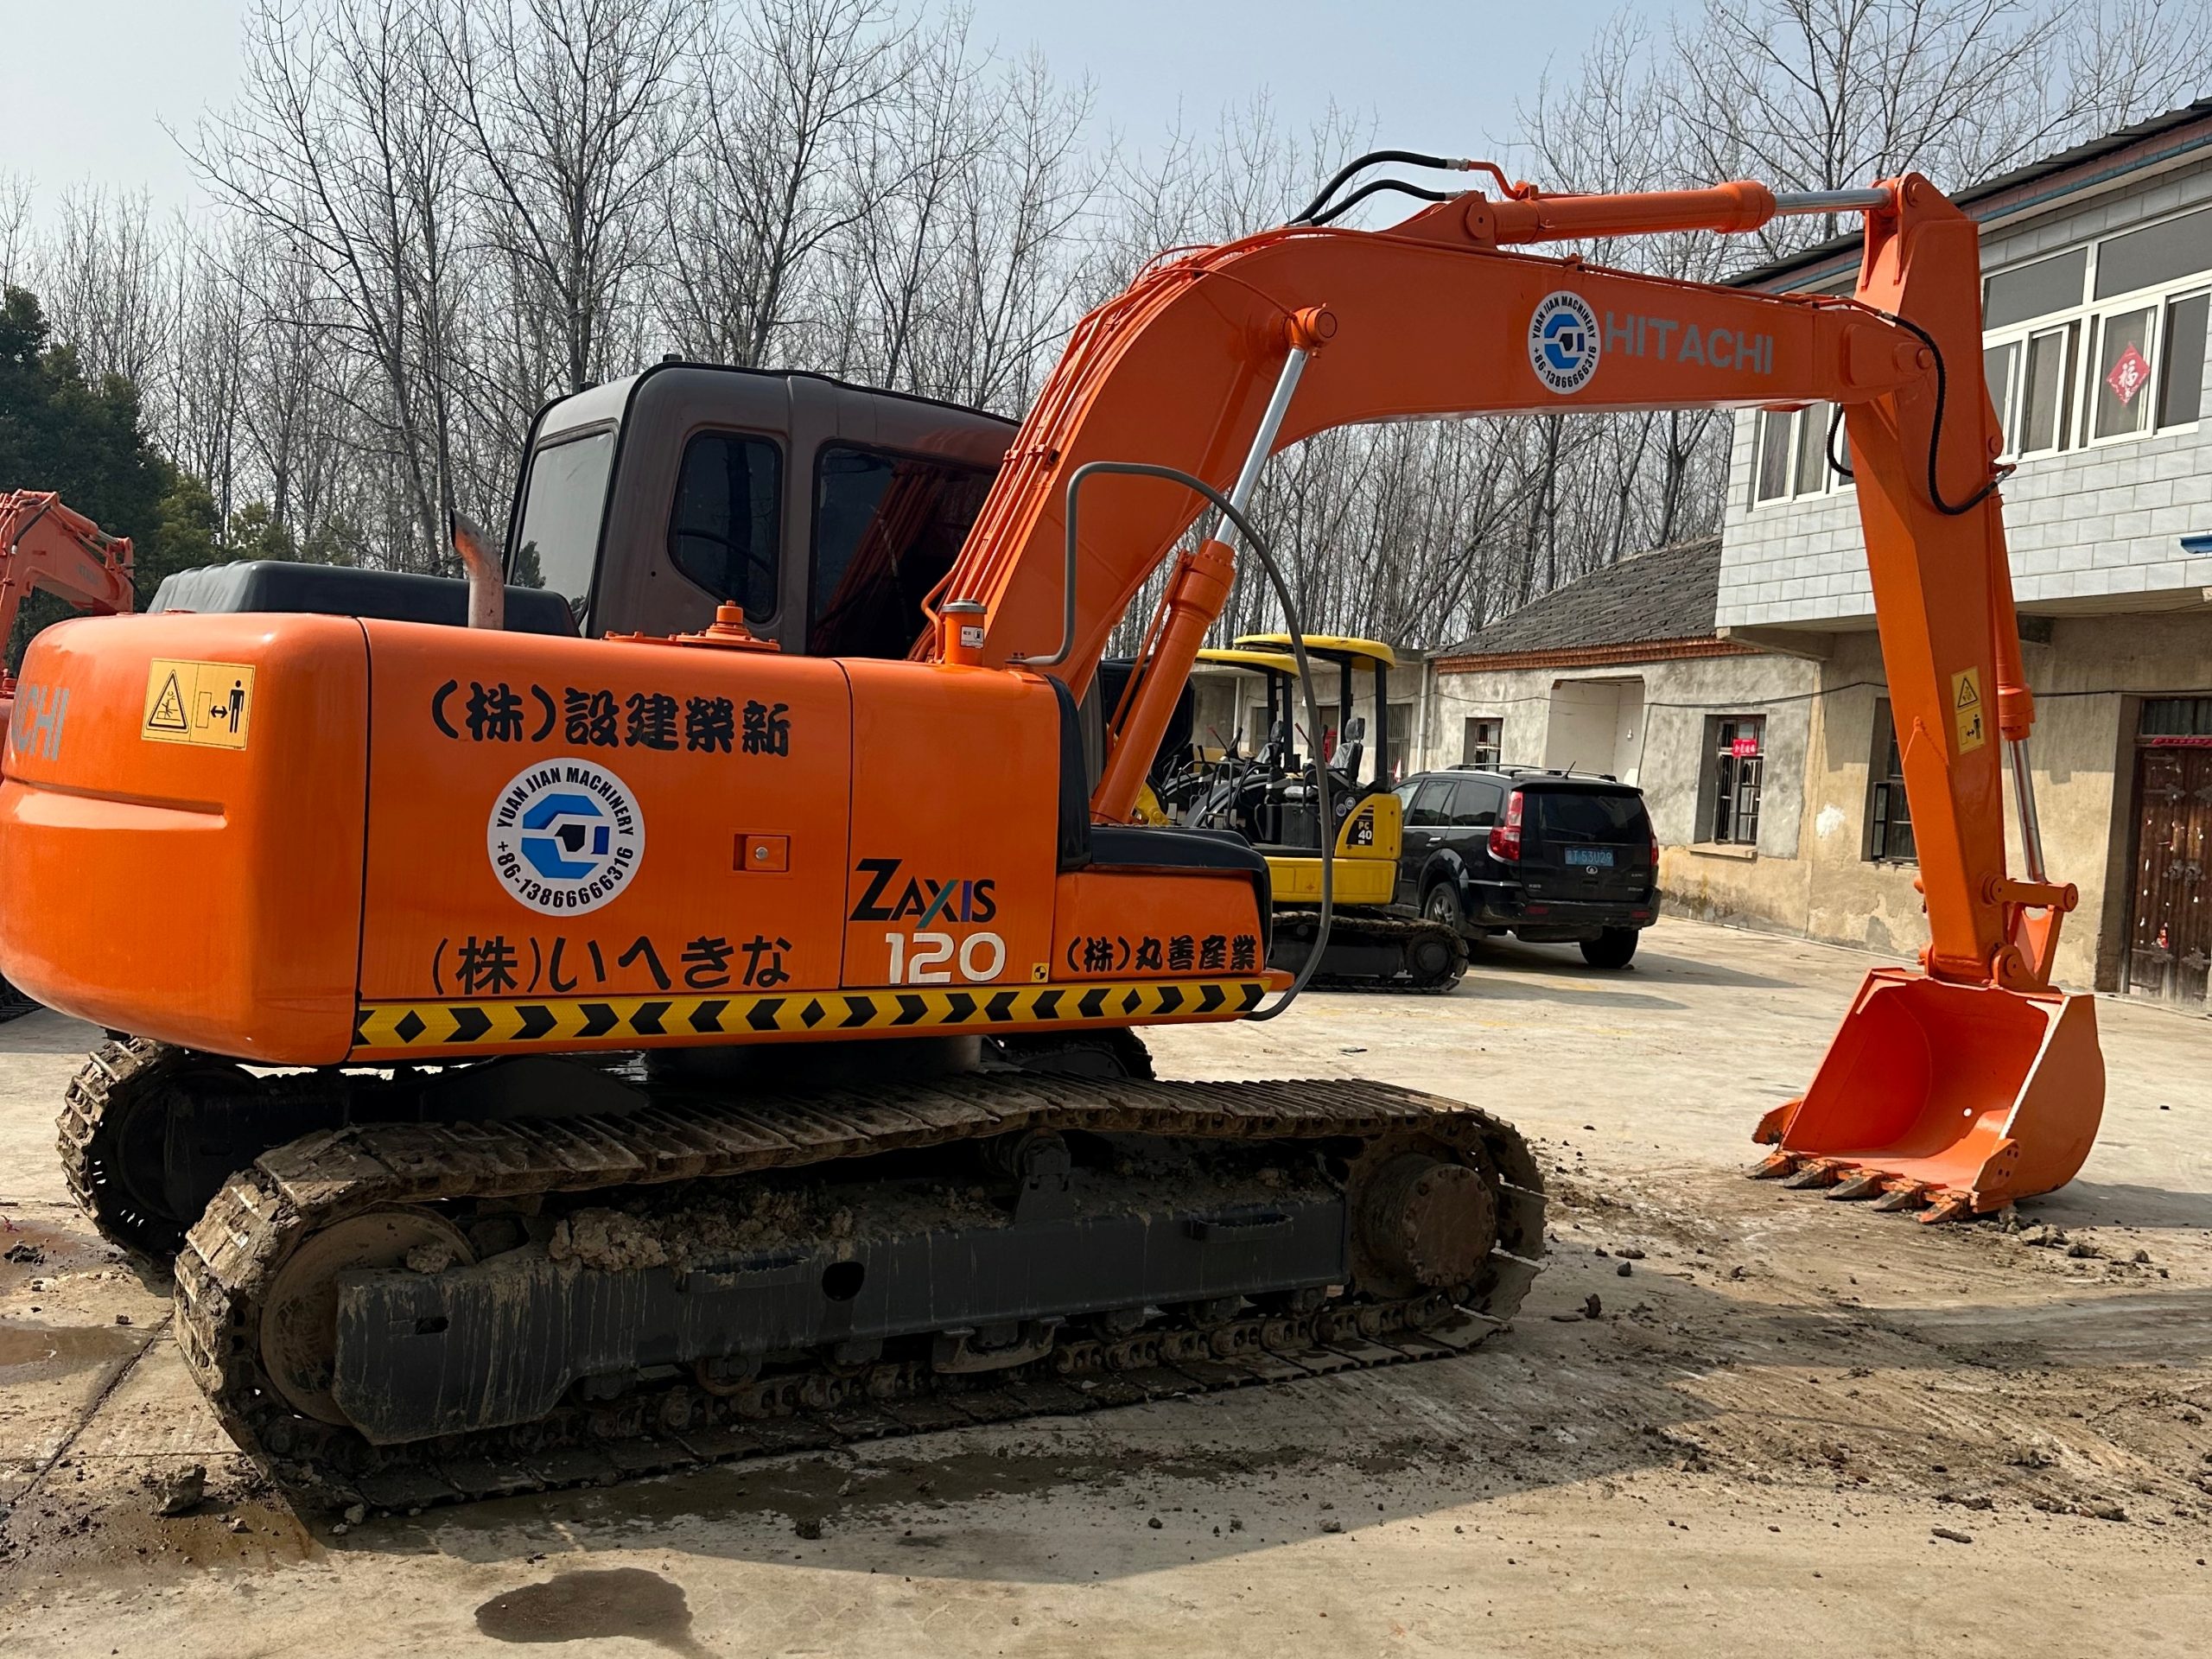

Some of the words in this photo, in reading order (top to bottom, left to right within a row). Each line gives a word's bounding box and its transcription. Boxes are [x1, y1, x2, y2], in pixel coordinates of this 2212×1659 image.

[1532, 312, 1546, 339] YUAN
[1543, 297, 1560, 315] JIAN
[1561, 296, 1597, 338] MACHINERY
[1605, 310, 1774, 375] HITACHI
[497, 785, 529, 828] YUAN
[525, 767, 562, 793] JIAN
[566, 766, 634, 836] MACHINERY
[1358, 821, 1370, 830] PC
[1357, 830, 1372, 840] 40
[497, 841, 634, 908] +86-13866666316
[849, 858, 996, 929] ZAXIS
[885, 931, 1007, 984] 120
